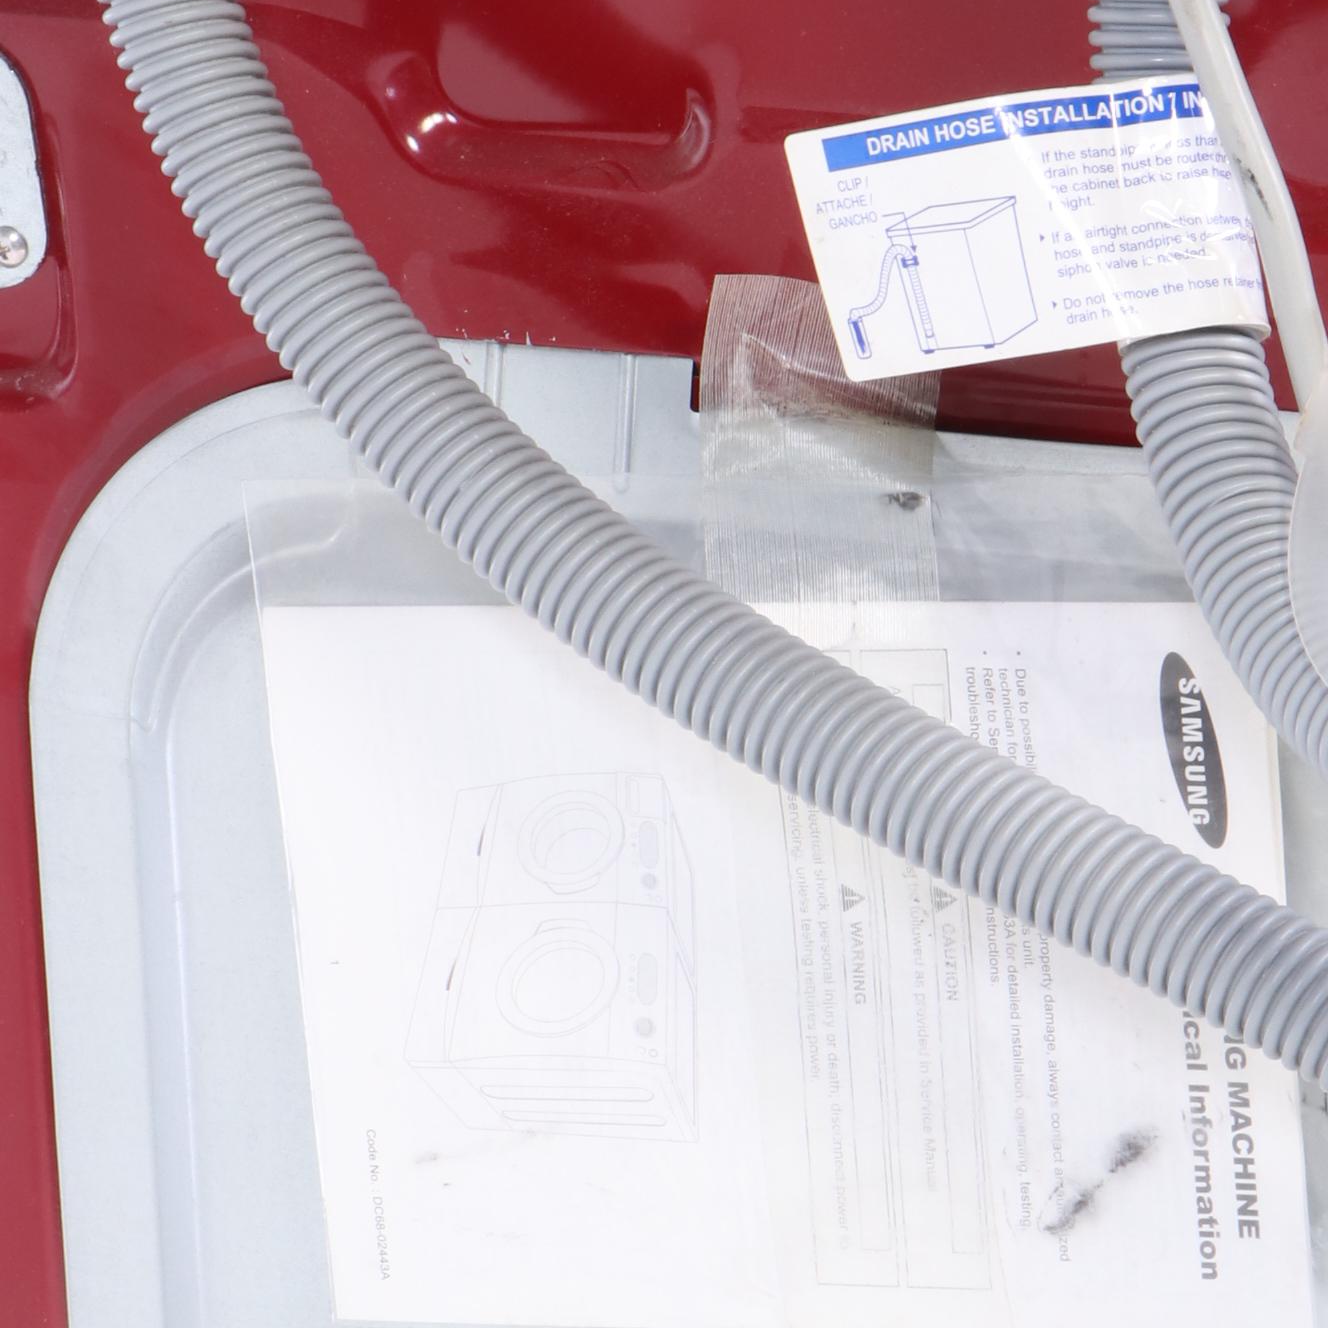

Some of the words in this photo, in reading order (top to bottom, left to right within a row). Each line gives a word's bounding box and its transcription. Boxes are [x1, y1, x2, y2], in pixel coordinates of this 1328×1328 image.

[864, 128, 931, 155] DRAIN
[932, 115, 998, 142] HOSE
[1043, 164, 1079, 179] drain
[1082, 161, 1115, 176] hose
[1154, 154, 1173, 166] be
[1053, 148, 1075, 161] the
[836, 177, 863, 192] CLIP
[1071, 176, 1120, 194] cabinet
[1122, 173, 1156, 188] back
[1175, 166, 1209, 180] raise
[814, 195, 867, 214] ATTACHE
[827, 210, 879, 229] GANCHO
[1084, 222, 1129, 241] airtight
[1089, 241, 1115, 255] and
[1105, 256, 1139, 271] valve
[1062, 296, 1082, 309] Do
[1162, 282, 1184, 294] the
[1187, 277, 1220, 291] hose
[1065, 310, 1098, 325] drain
[982, 667, 996, 703] Refer
[1014, 668, 1028, 696] Due
[985, 708, 997, 722] to
[998, 667, 1016, 737] technician
[1017, 701, 1029, 713] to
[1005, 741, 1018, 760] for
[1176, 677, 1210, 825] SAMSUNG
[983, 906, 1001, 987] nstructions.
[1004, 942, 1017, 961] for
[1021, 940, 1034, 968] unit.
[847, 921, 867, 1005] WARNING
[940, 923, 960, 1001] CAUTION
[1005, 965, 1021, 1020] detailed
[1039, 994, 1058, 1055] damage,
[825, 1032, 836, 1048] or
[365, 1129, 378, 1160] Code
[1226, 1081, 1260, 1238] MACHINE
[1185, 1084, 1224, 1279] Information
[371, 1196, 390, 1280] DC68-02443A
